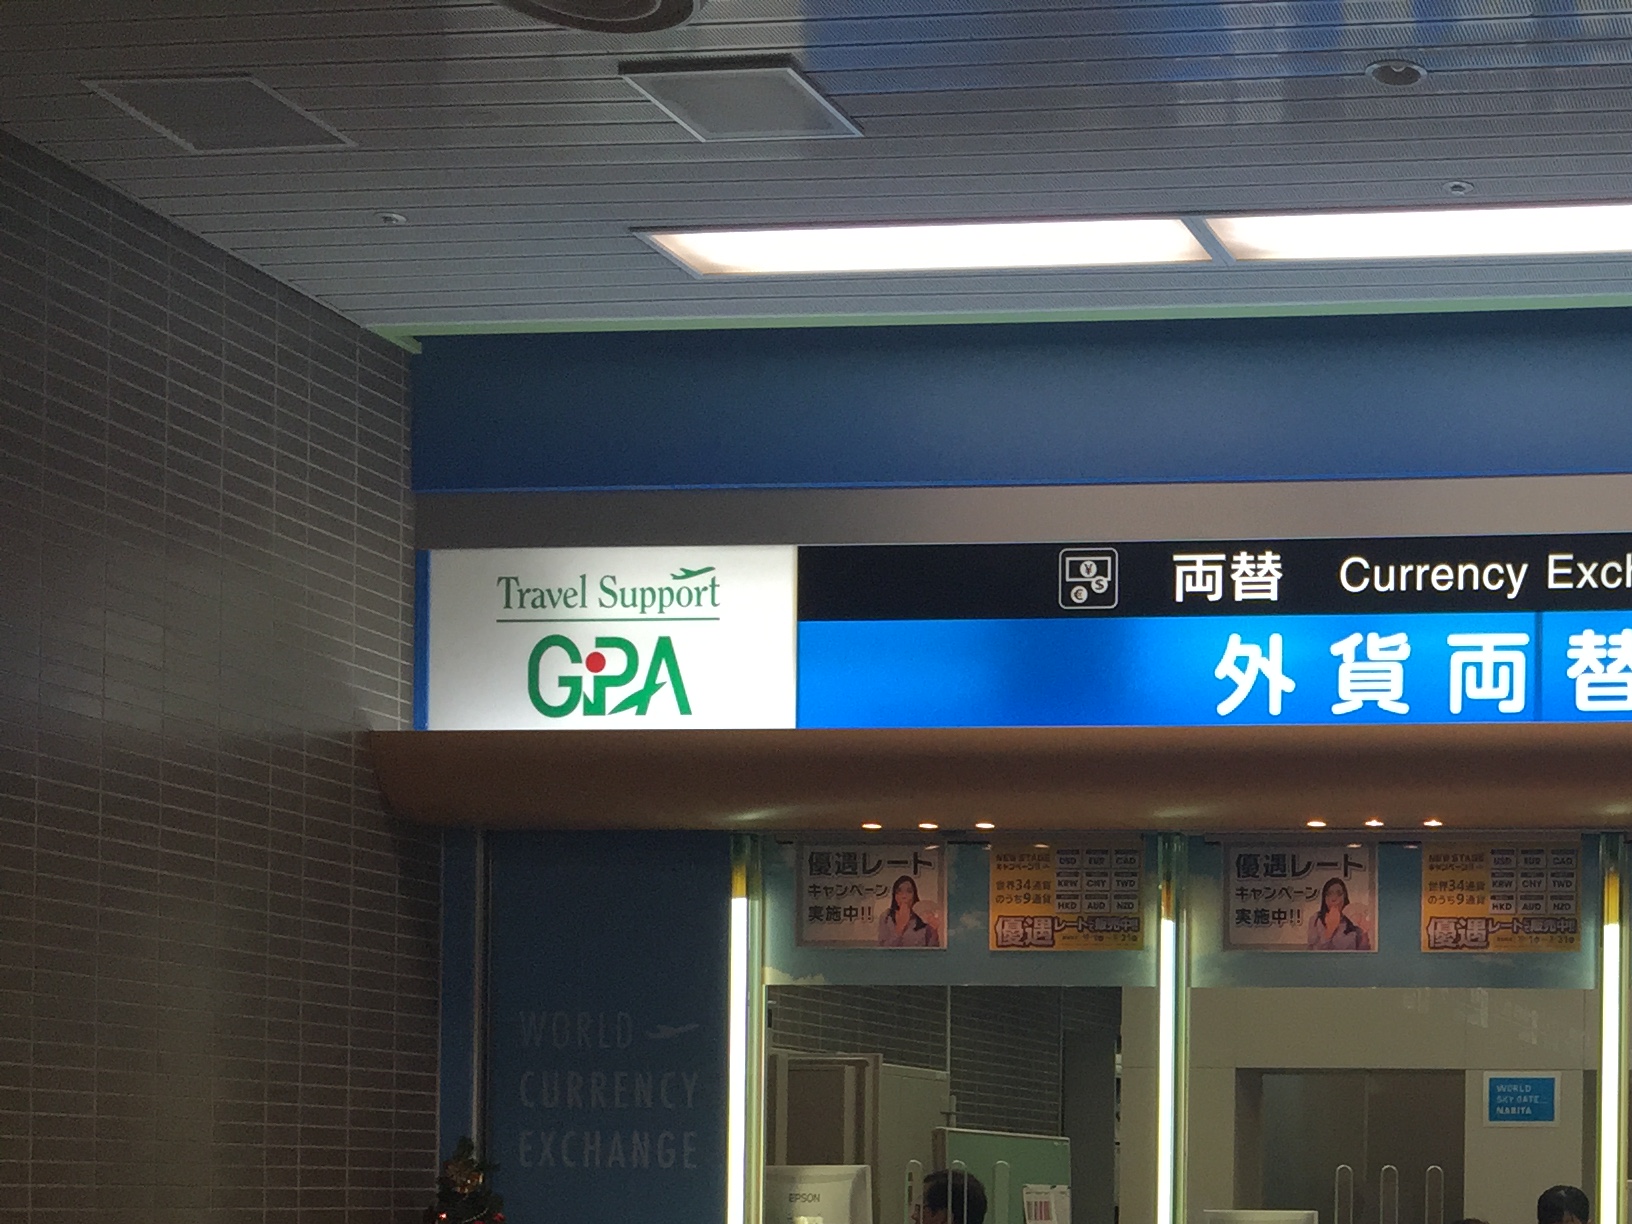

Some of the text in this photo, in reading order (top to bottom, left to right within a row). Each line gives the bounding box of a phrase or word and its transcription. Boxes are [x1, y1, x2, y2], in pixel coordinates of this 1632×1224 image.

[497, 574, 720, 615] Travel Support
[1173, 552, 1282, 601] 両替
[1339, 557, 1527, 600] Currency
[527, 634, 692, 718] GPA
[519, 1011, 633, 1049] WORLD
[520, 1071, 698, 1109] CURRENCY
[519, 1131, 698, 1169] EXCHANGE
[788, 1193, 820, 1204] EPSON
